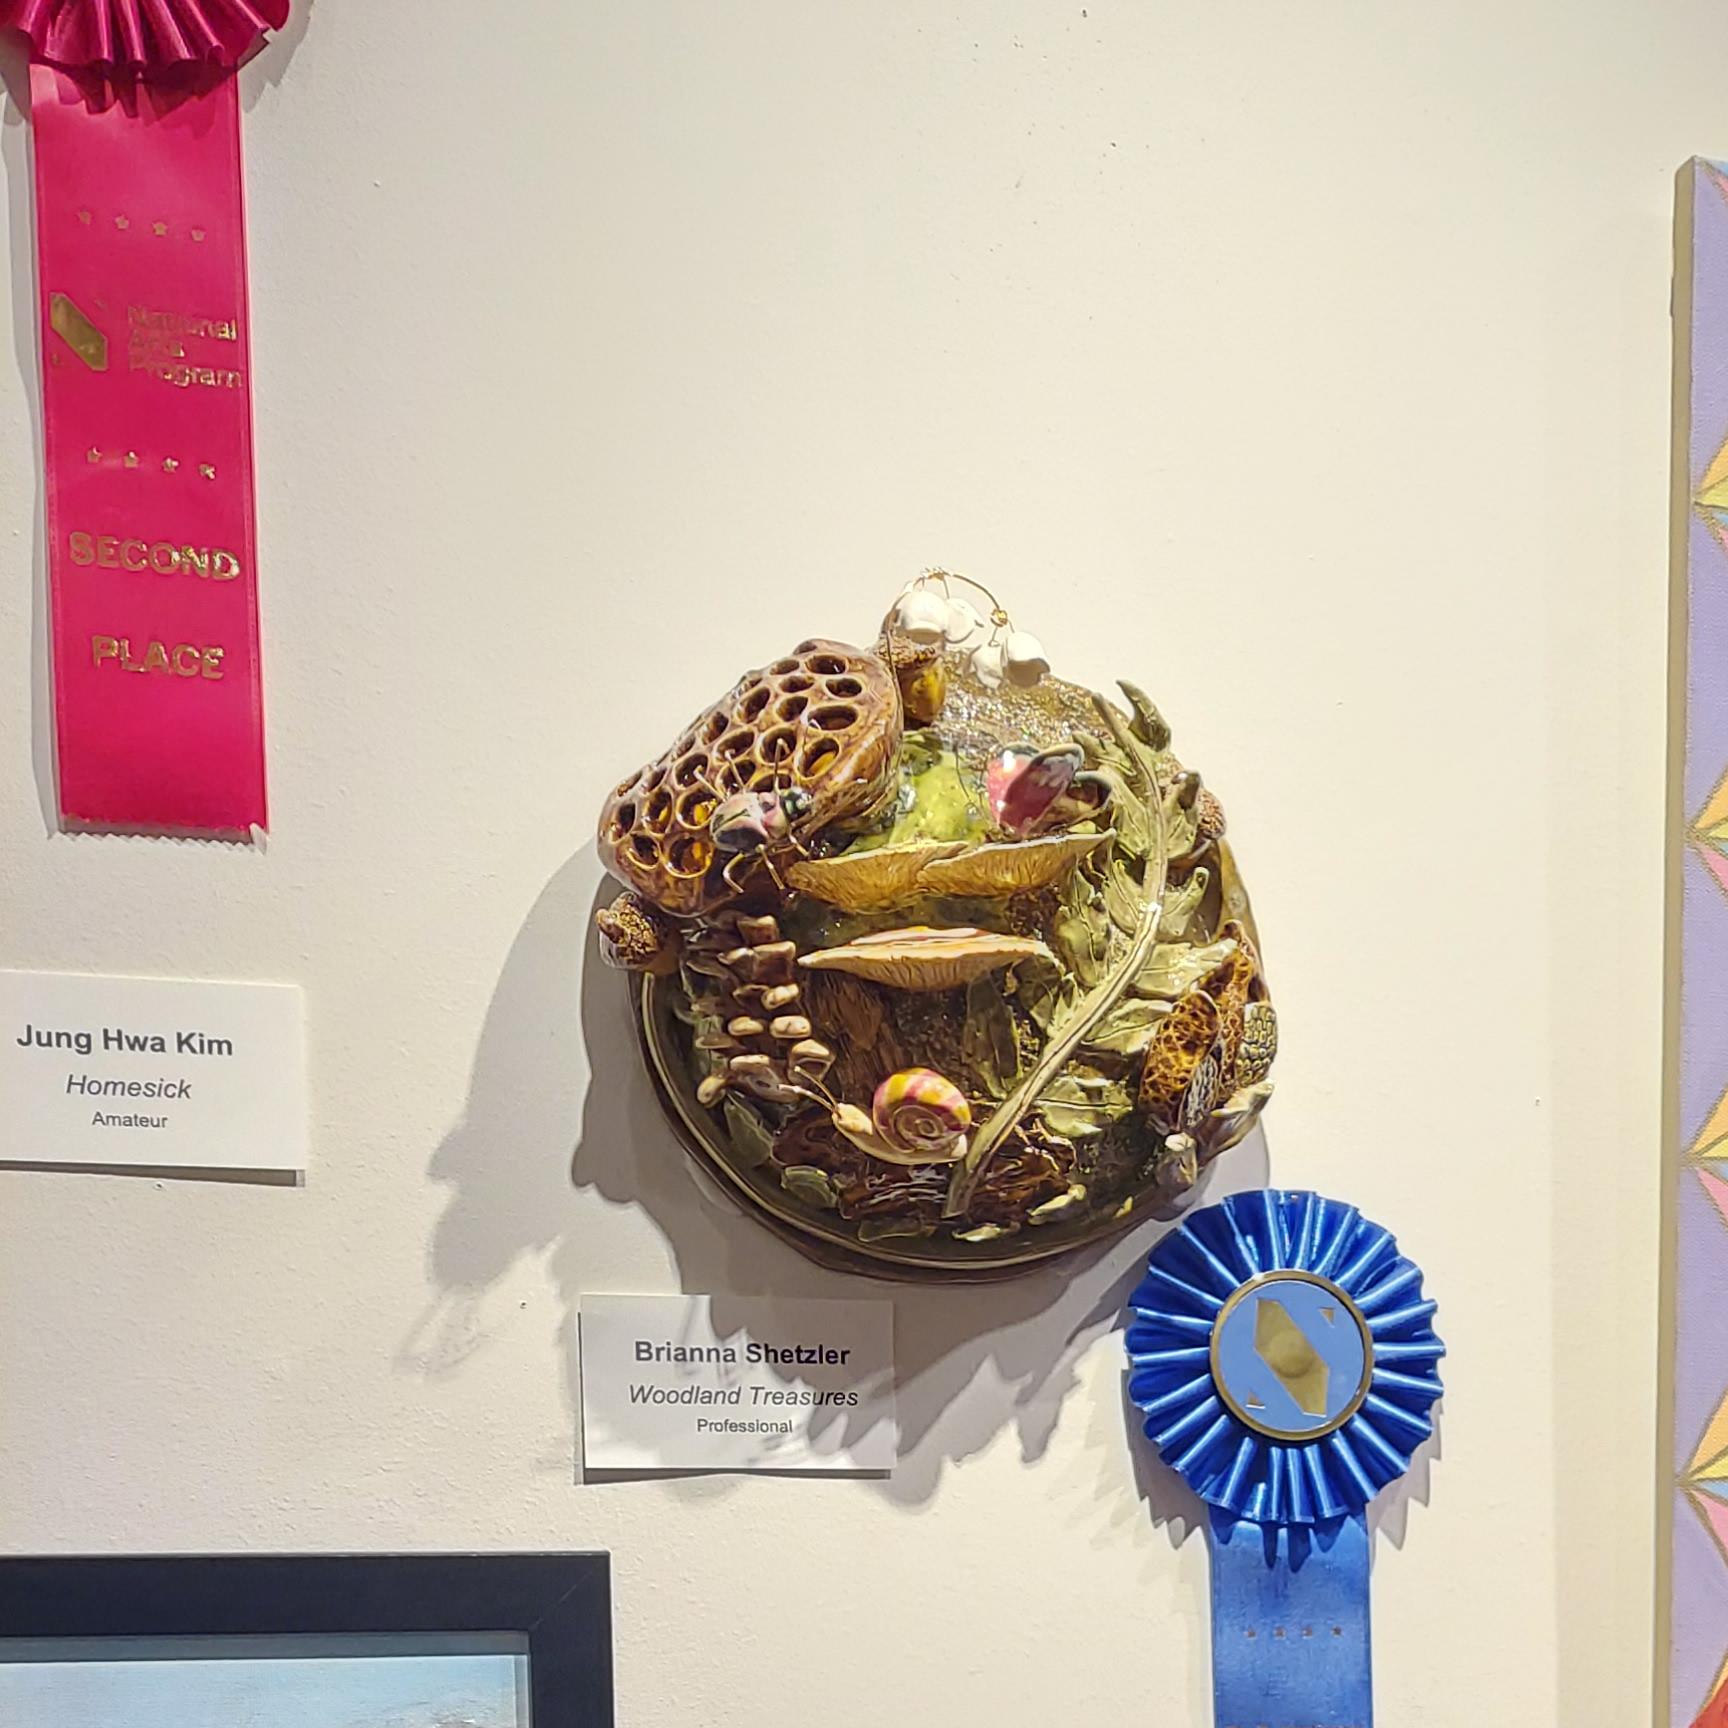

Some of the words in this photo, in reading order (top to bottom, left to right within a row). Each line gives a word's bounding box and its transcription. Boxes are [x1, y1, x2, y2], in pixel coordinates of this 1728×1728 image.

[128, 305, 238, 341] National
[69, 531, 241, 580] SECOND
[92, 634, 225, 680] PLACE
[16, 1024, 92, 1055] Jung
[102, 1028, 167, 1053] Hwa
[176, 1031, 233, 1056] Kim
[66, 1074, 192, 1099] Homesick
[92, 1111, 168, 1128] Amateur
[635, 1341, 736, 1363] Brianna
[745, 1343, 850, 1365] Shetzler
[629, 1385, 740, 1405] Woodland
[750, 1386, 858, 1406] Treasures
[697, 1418, 793, 1433] Professional
